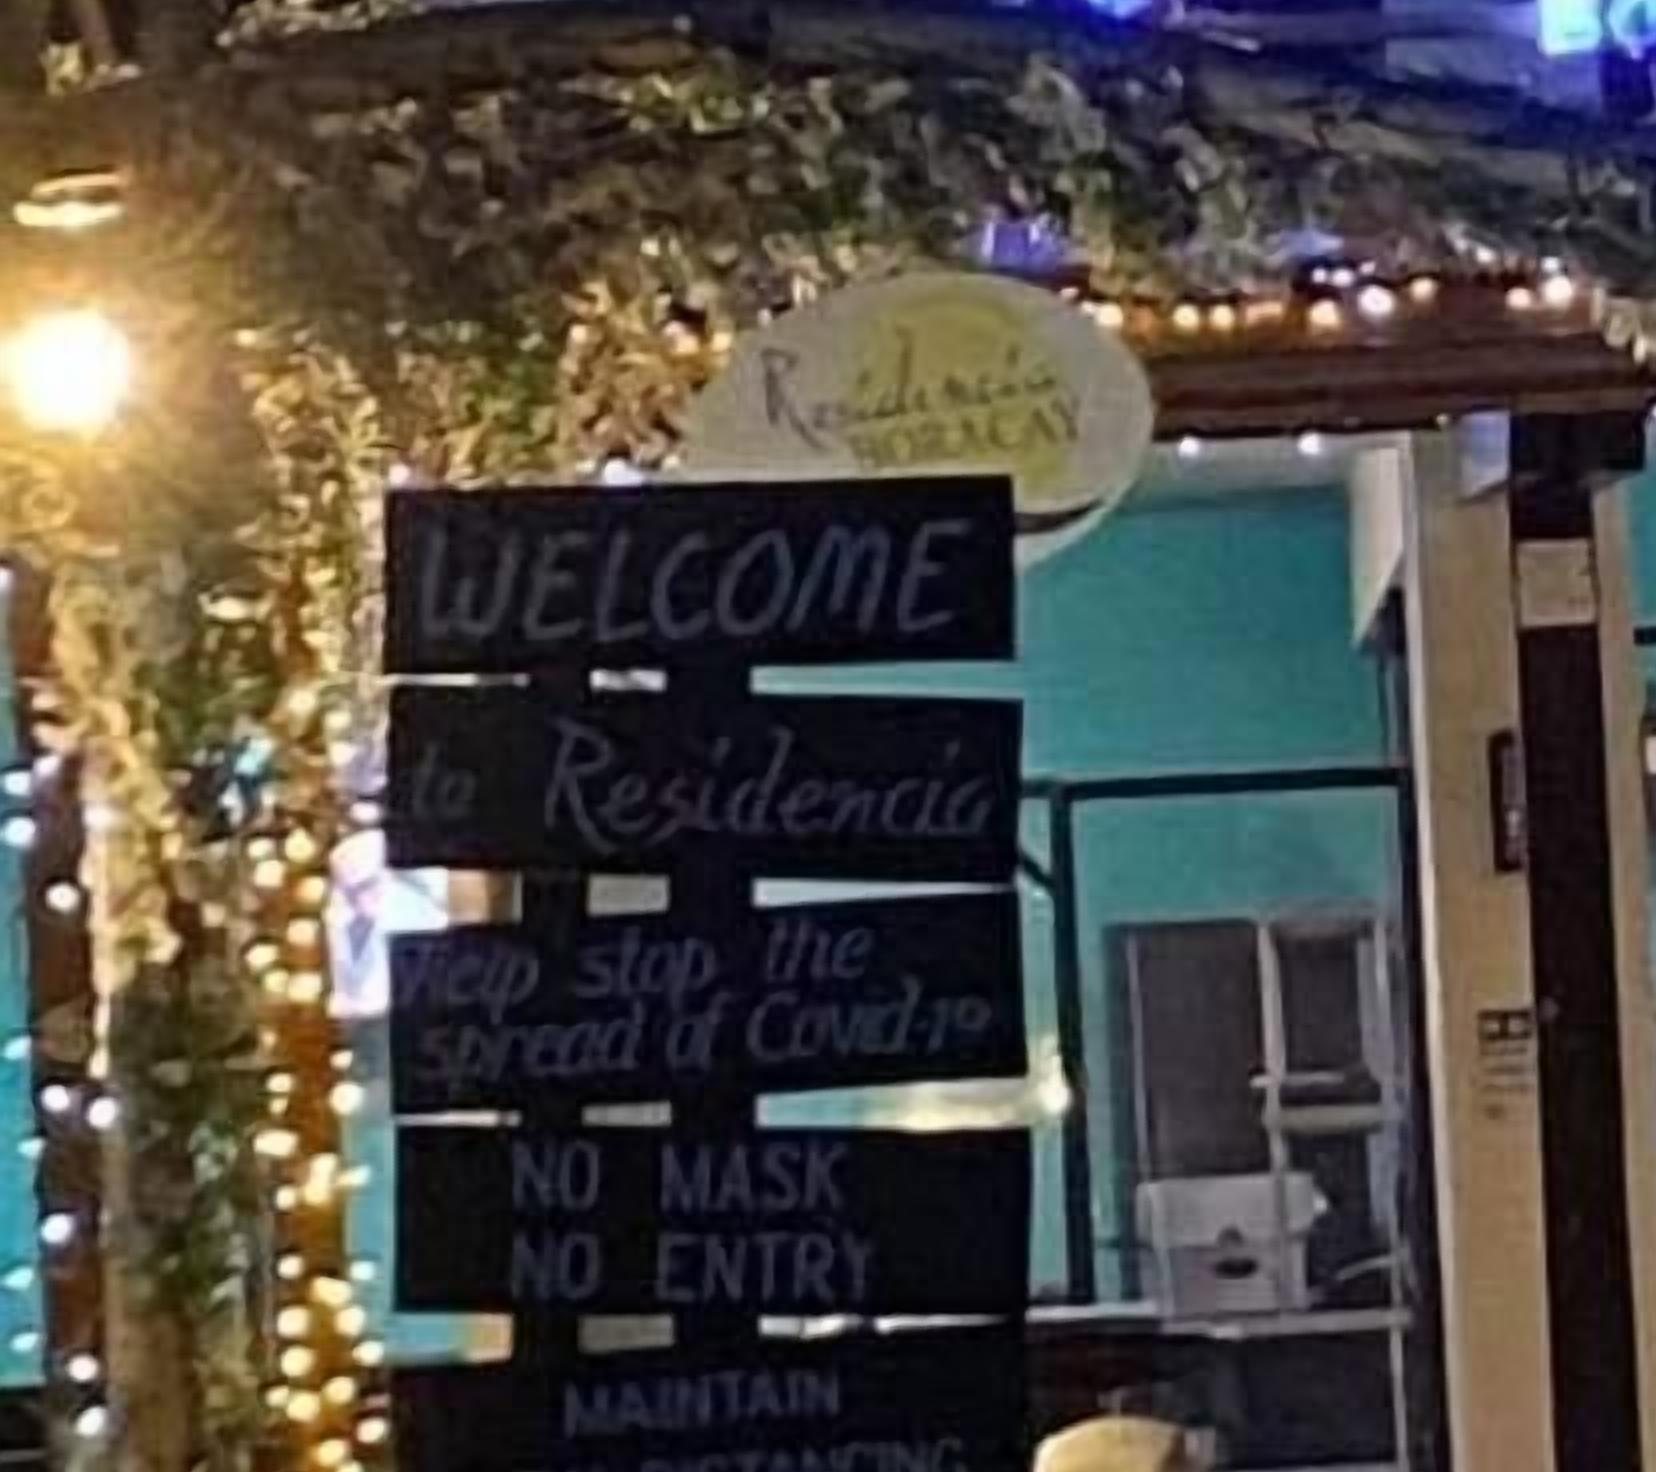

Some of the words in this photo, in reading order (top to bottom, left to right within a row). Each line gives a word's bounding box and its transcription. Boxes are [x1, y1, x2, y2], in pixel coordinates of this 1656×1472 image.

[416, 517, 972, 642] WELCOME
[408, 740, 479, 818] to
[543, 714, 996, 854] Residencia
[577, 928, 716, 1006] stop
[762, 917, 876, 983] the
[414, 999, 644, 1088] spread
[511, 1140, 600, 1210] NO
[658, 1140, 850, 1211] MASK
[511, 1231, 600, 1303] NO
[655, 1230, 877, 1304] ENTRY
[564, 1369, 843, 1437] MAINTAIN
